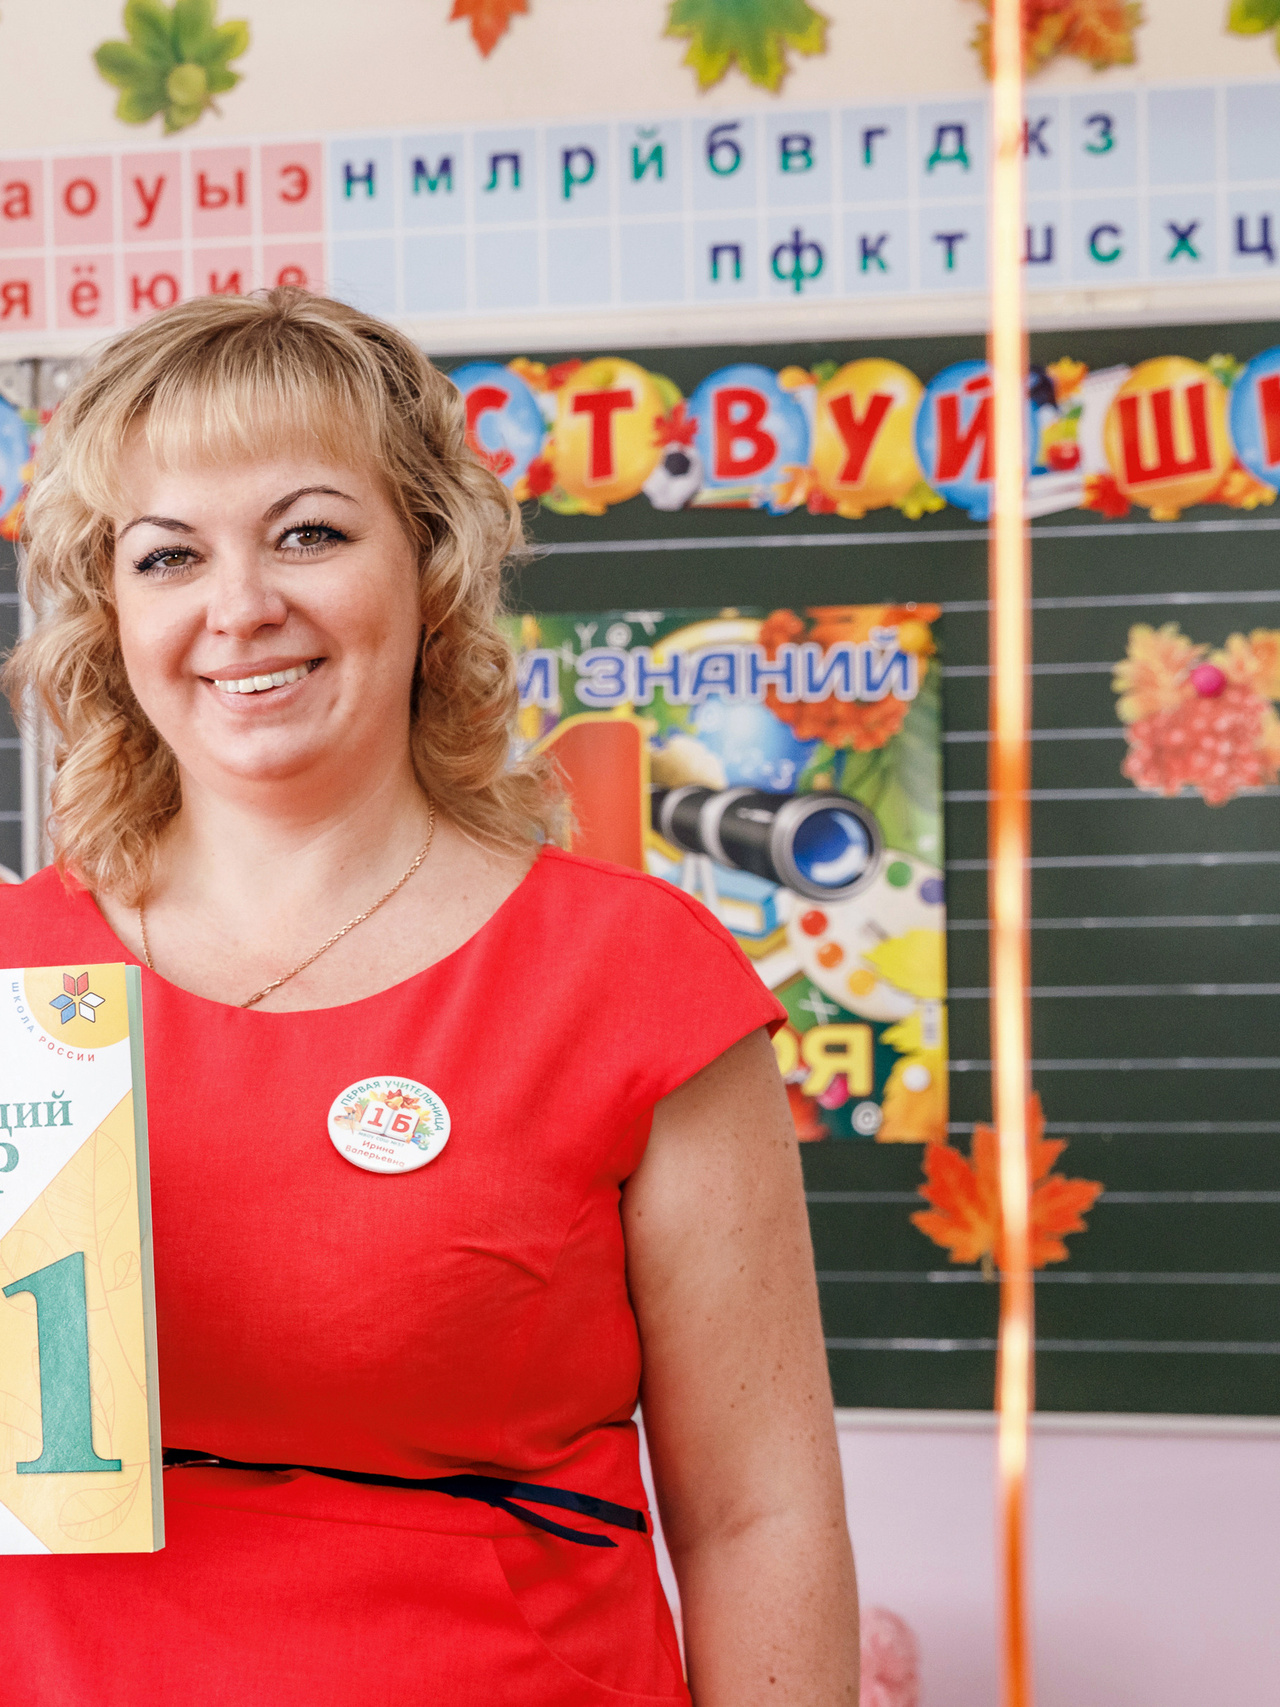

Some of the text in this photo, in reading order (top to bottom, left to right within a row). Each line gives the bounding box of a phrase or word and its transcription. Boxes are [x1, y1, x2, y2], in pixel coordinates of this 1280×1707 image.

[2, 180, 32, 220] а
[63, 178, 98, 217] о
[134, 174, 166, 228] у
[197, 169, 247, 209] ы
[279, 163, 310, 204] э
[343, 160, 375, 199] н
[411, 154, 455, 194] м
[483, 151, 522, 192] л
[562, 144, 597, 199] р
[630, 127, 665, 183] й
[707, 122, 743, 176] б
[780, 132, 813, 173] в
[862, 127, 888, 167] г
[927, 123, 971, 172] д
[0, 280, 31, 320] я
[71, 265, 99, 318] ё
[131, 273, 179, 311] ю
[710, 243, 743, 282] п
[771, 227, 825, 294] ф
[860, 232, 889, 273] к
[934, 231, 967, 272] т
[1087, 223, 1122, 263] с
[1166, 220, 1201, 262] х
[1236, 213, 1278, 262] ц
[577, 628, 918, 706] ЗНАНИЙ
[11, 981, 95, 1062] ШКОЛА РОССИИ
[340, 1080, 444, 1131] ПЕРВАЯ УЧИТЕЛЬНИЦА
[345, 1144, 405, 1168] Валерьевна
[362, 1140, 395, 1155] Ирина
[1, 1251, 122, 1475] 1
